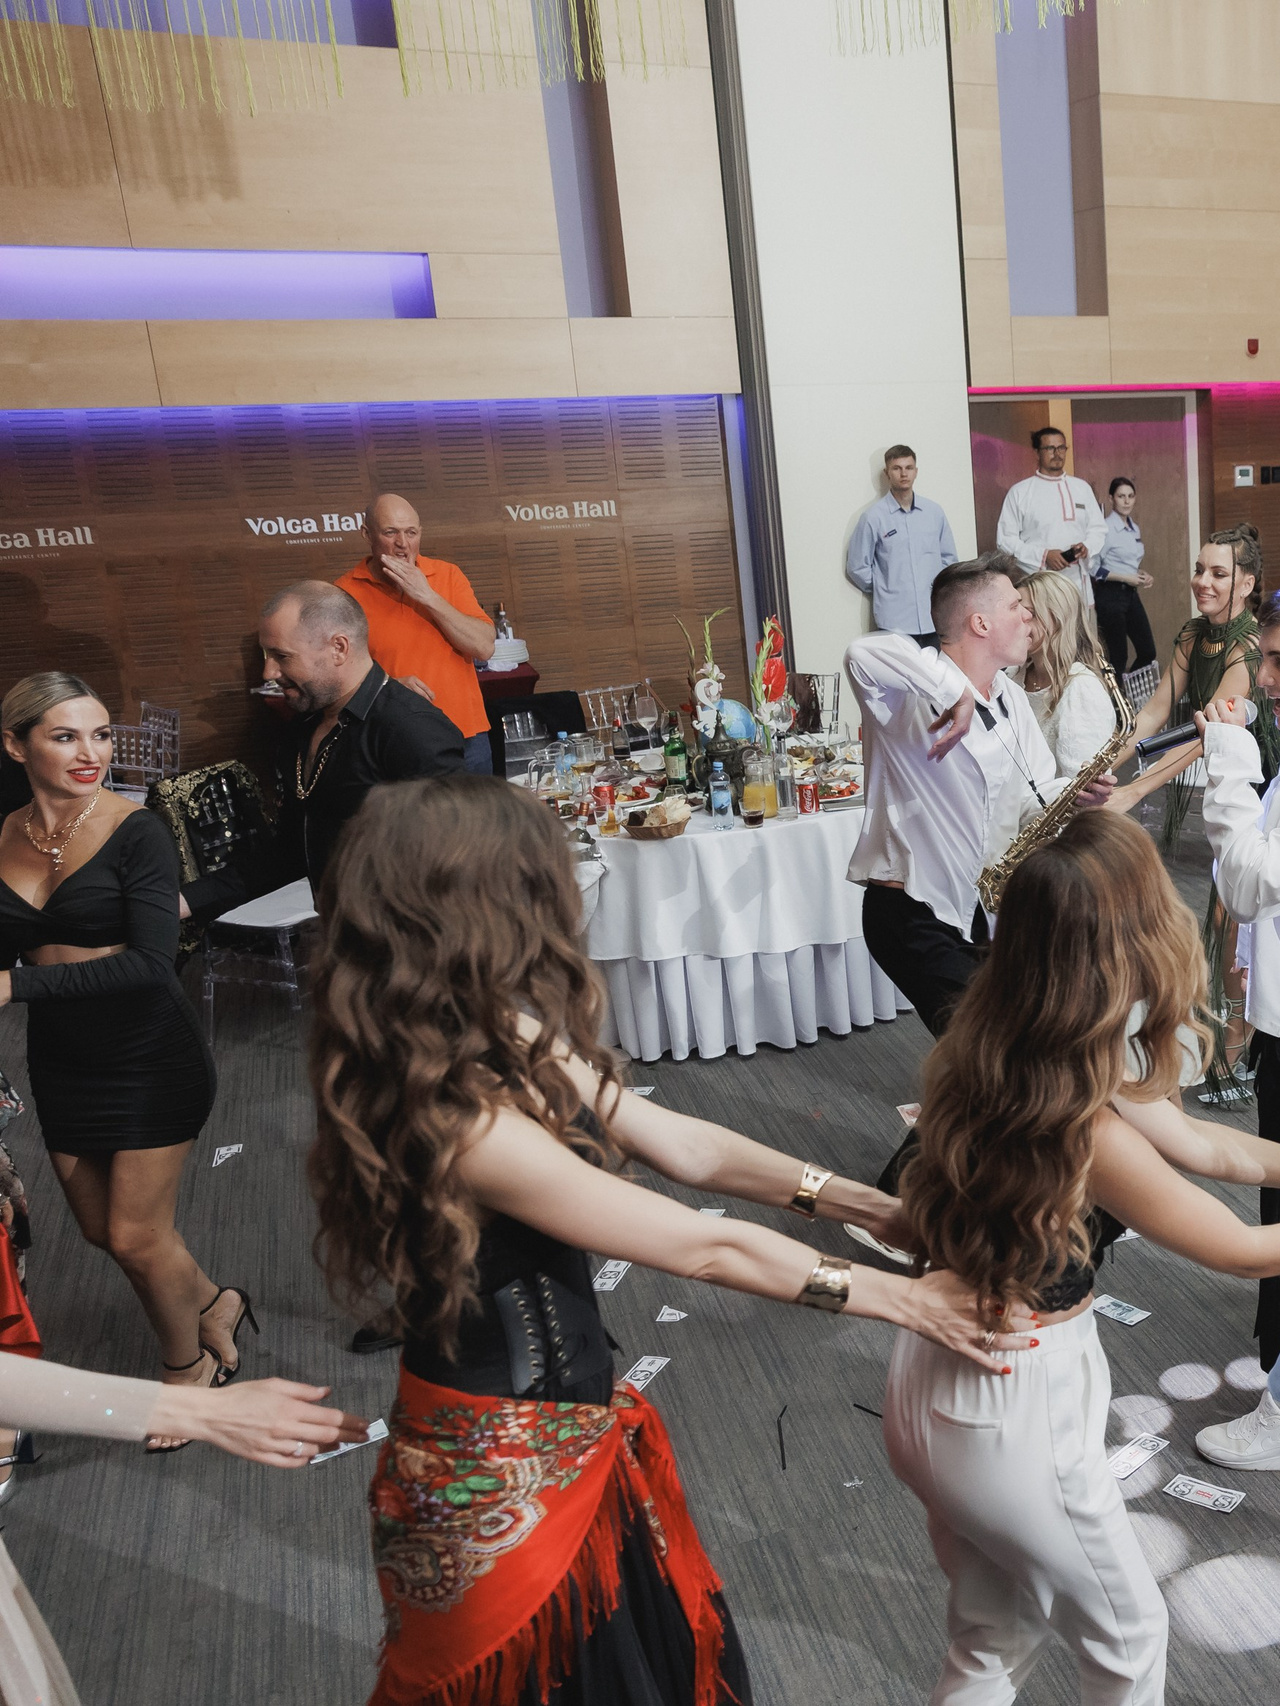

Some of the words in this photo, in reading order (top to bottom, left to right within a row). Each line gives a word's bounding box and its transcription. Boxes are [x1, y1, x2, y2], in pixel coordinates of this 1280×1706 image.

[505, 504, 570, 522] Volga
[572, 499, 618, 518] Hall
[35, 526, 95, 547] Hall
[244, 516, 319, 536] Volga
